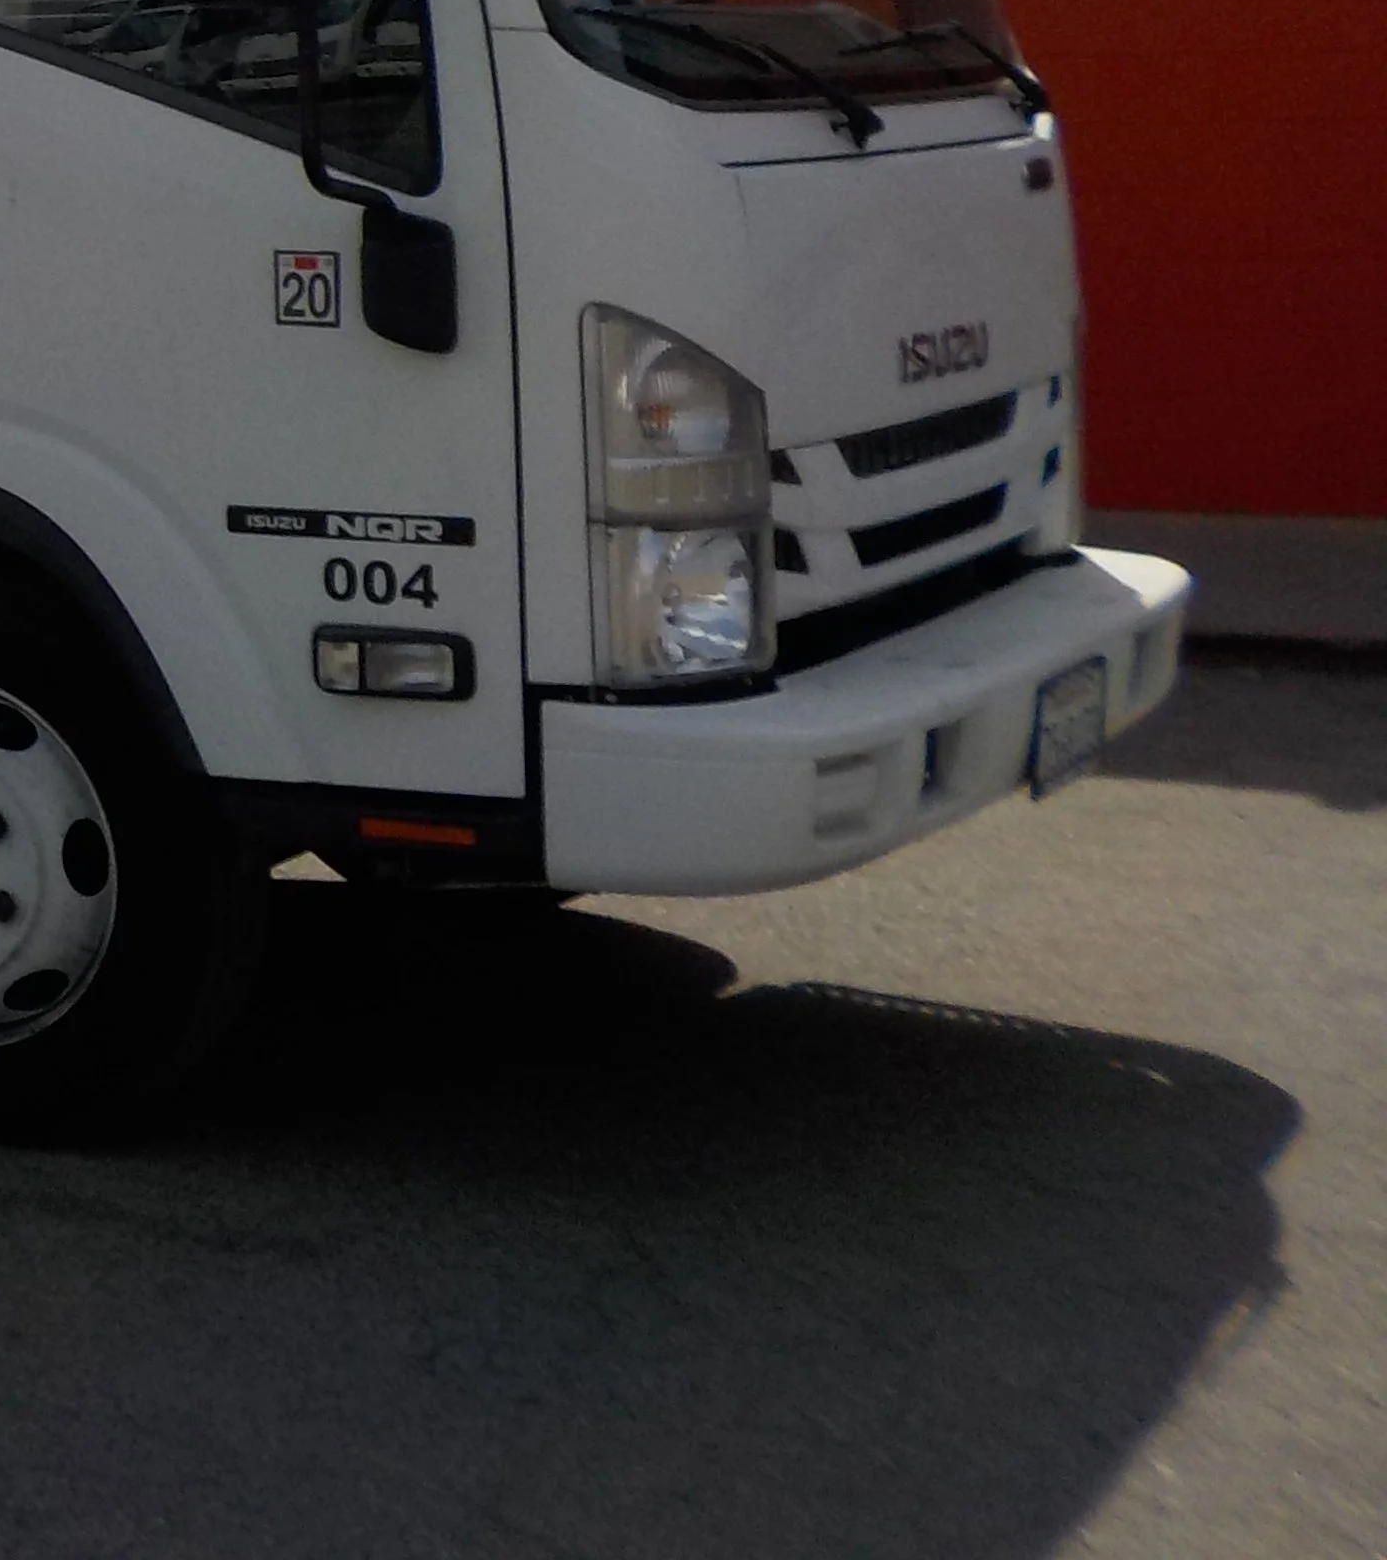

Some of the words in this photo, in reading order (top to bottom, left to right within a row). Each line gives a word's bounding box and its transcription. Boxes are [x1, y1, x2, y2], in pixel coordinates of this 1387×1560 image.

[282, 272, 332, 318] 20
[898, 319, 988, 384] ISUZU
[246, 513, 307, 531] ISUZU
[325, 513, 444, 543] NQR
[323, 556, 439, 609] 004
